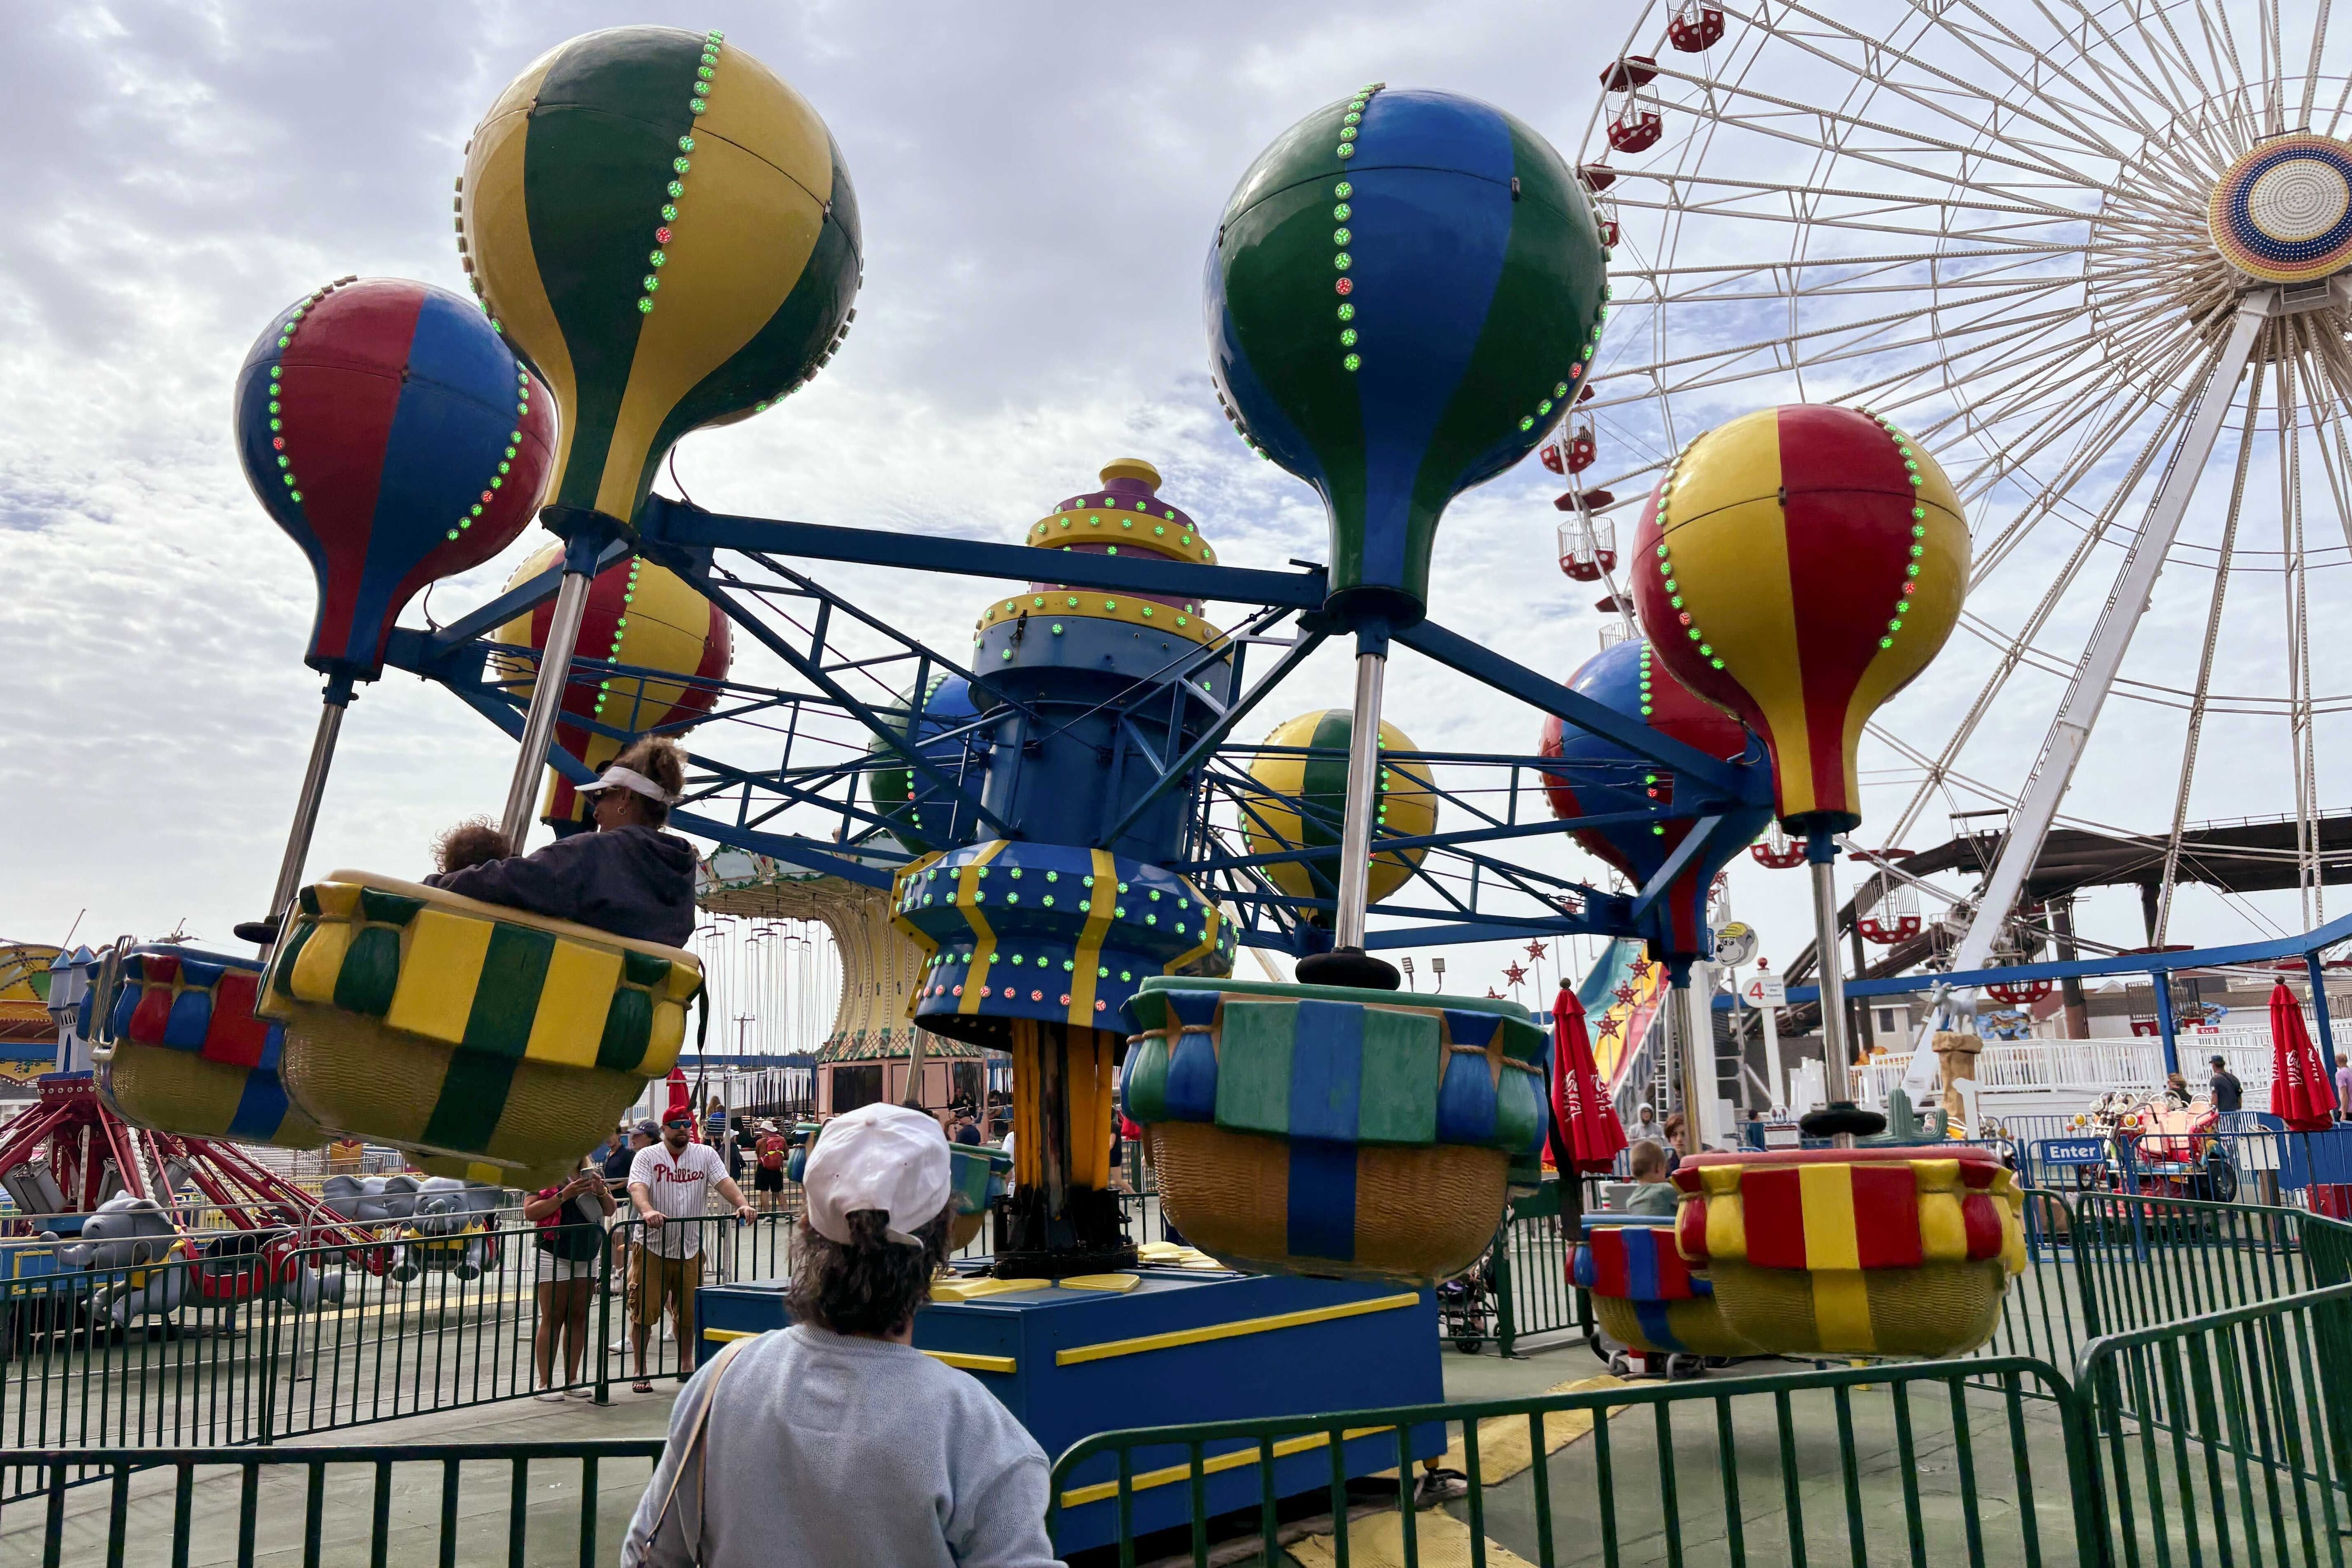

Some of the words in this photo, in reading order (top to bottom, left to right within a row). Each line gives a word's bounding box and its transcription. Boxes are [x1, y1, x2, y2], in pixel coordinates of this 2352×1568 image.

[1749, 981, 1764, 1000] 4
[2050, 1146, 2096, 1158] Enter
[653, 1163, 704, 1183] Phillies
